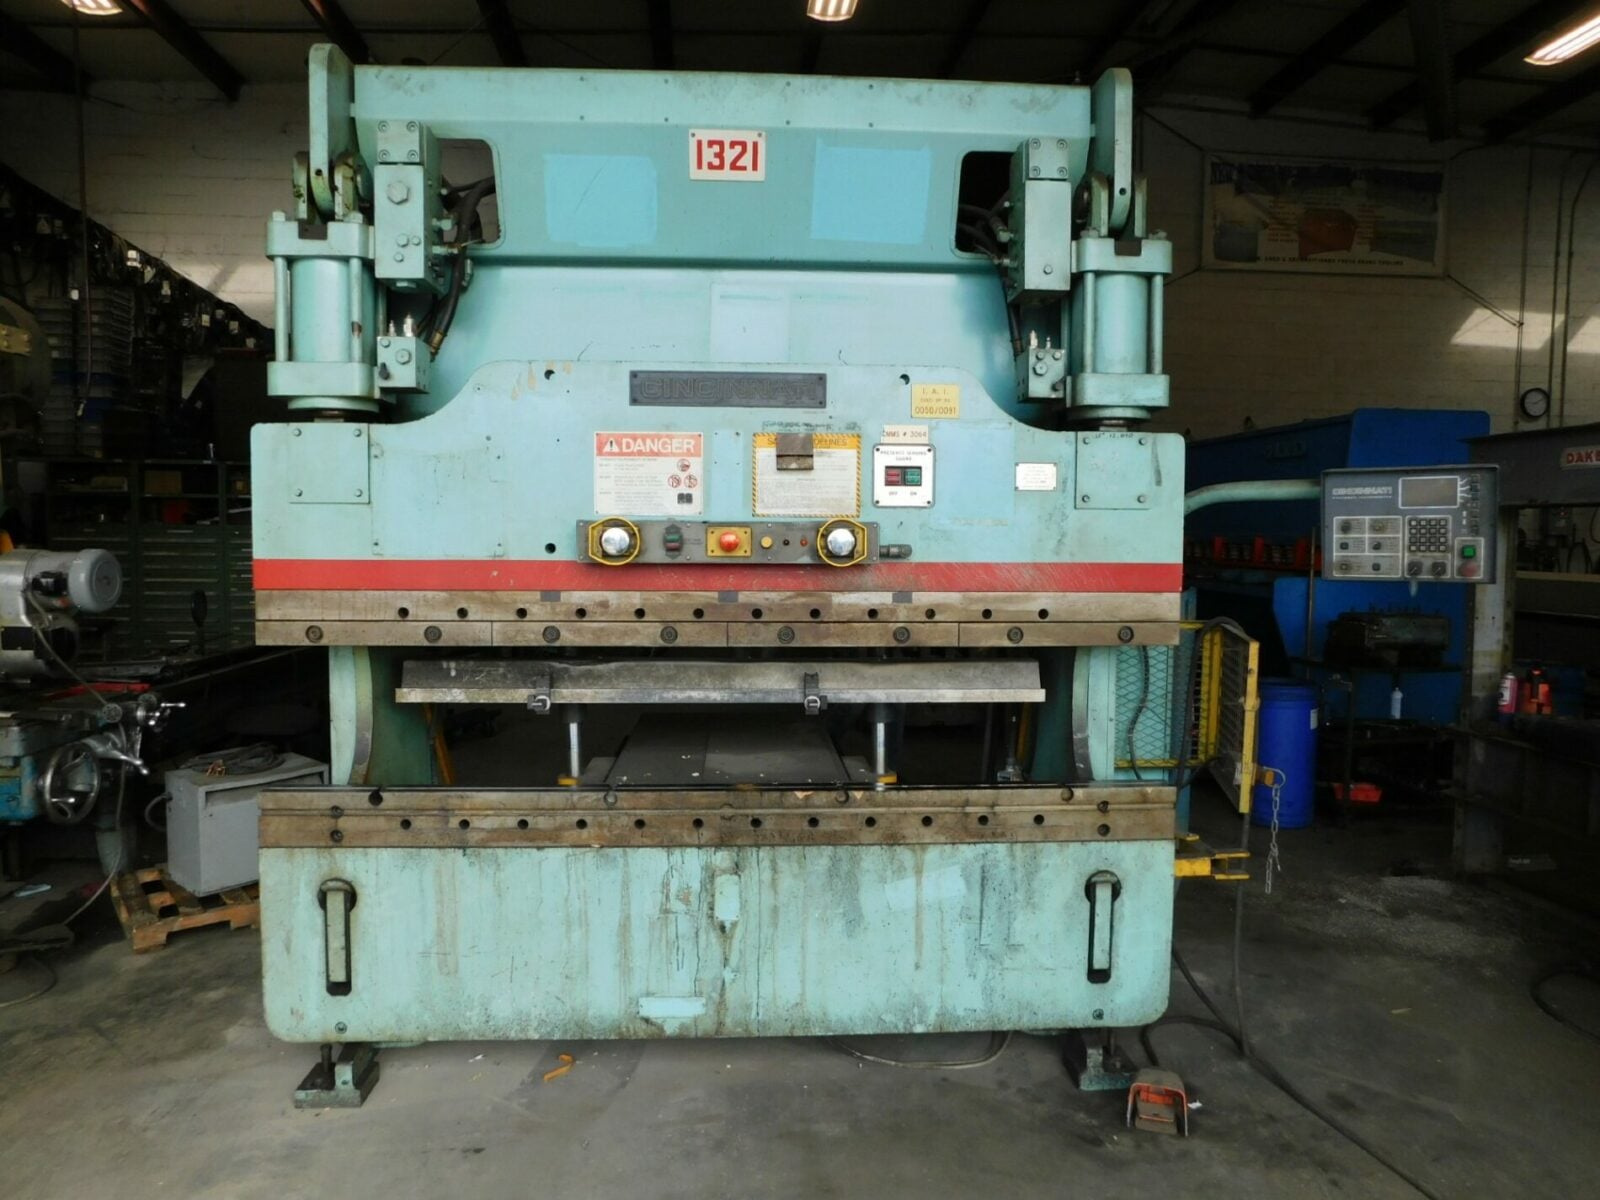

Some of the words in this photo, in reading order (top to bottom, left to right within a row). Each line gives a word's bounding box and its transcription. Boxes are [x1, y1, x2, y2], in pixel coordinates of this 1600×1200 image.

[696, 139, 759, 172] 1321
[640, 376, 818, 401] CINCINNATI
[622, 438, 695, 453] DANGER
